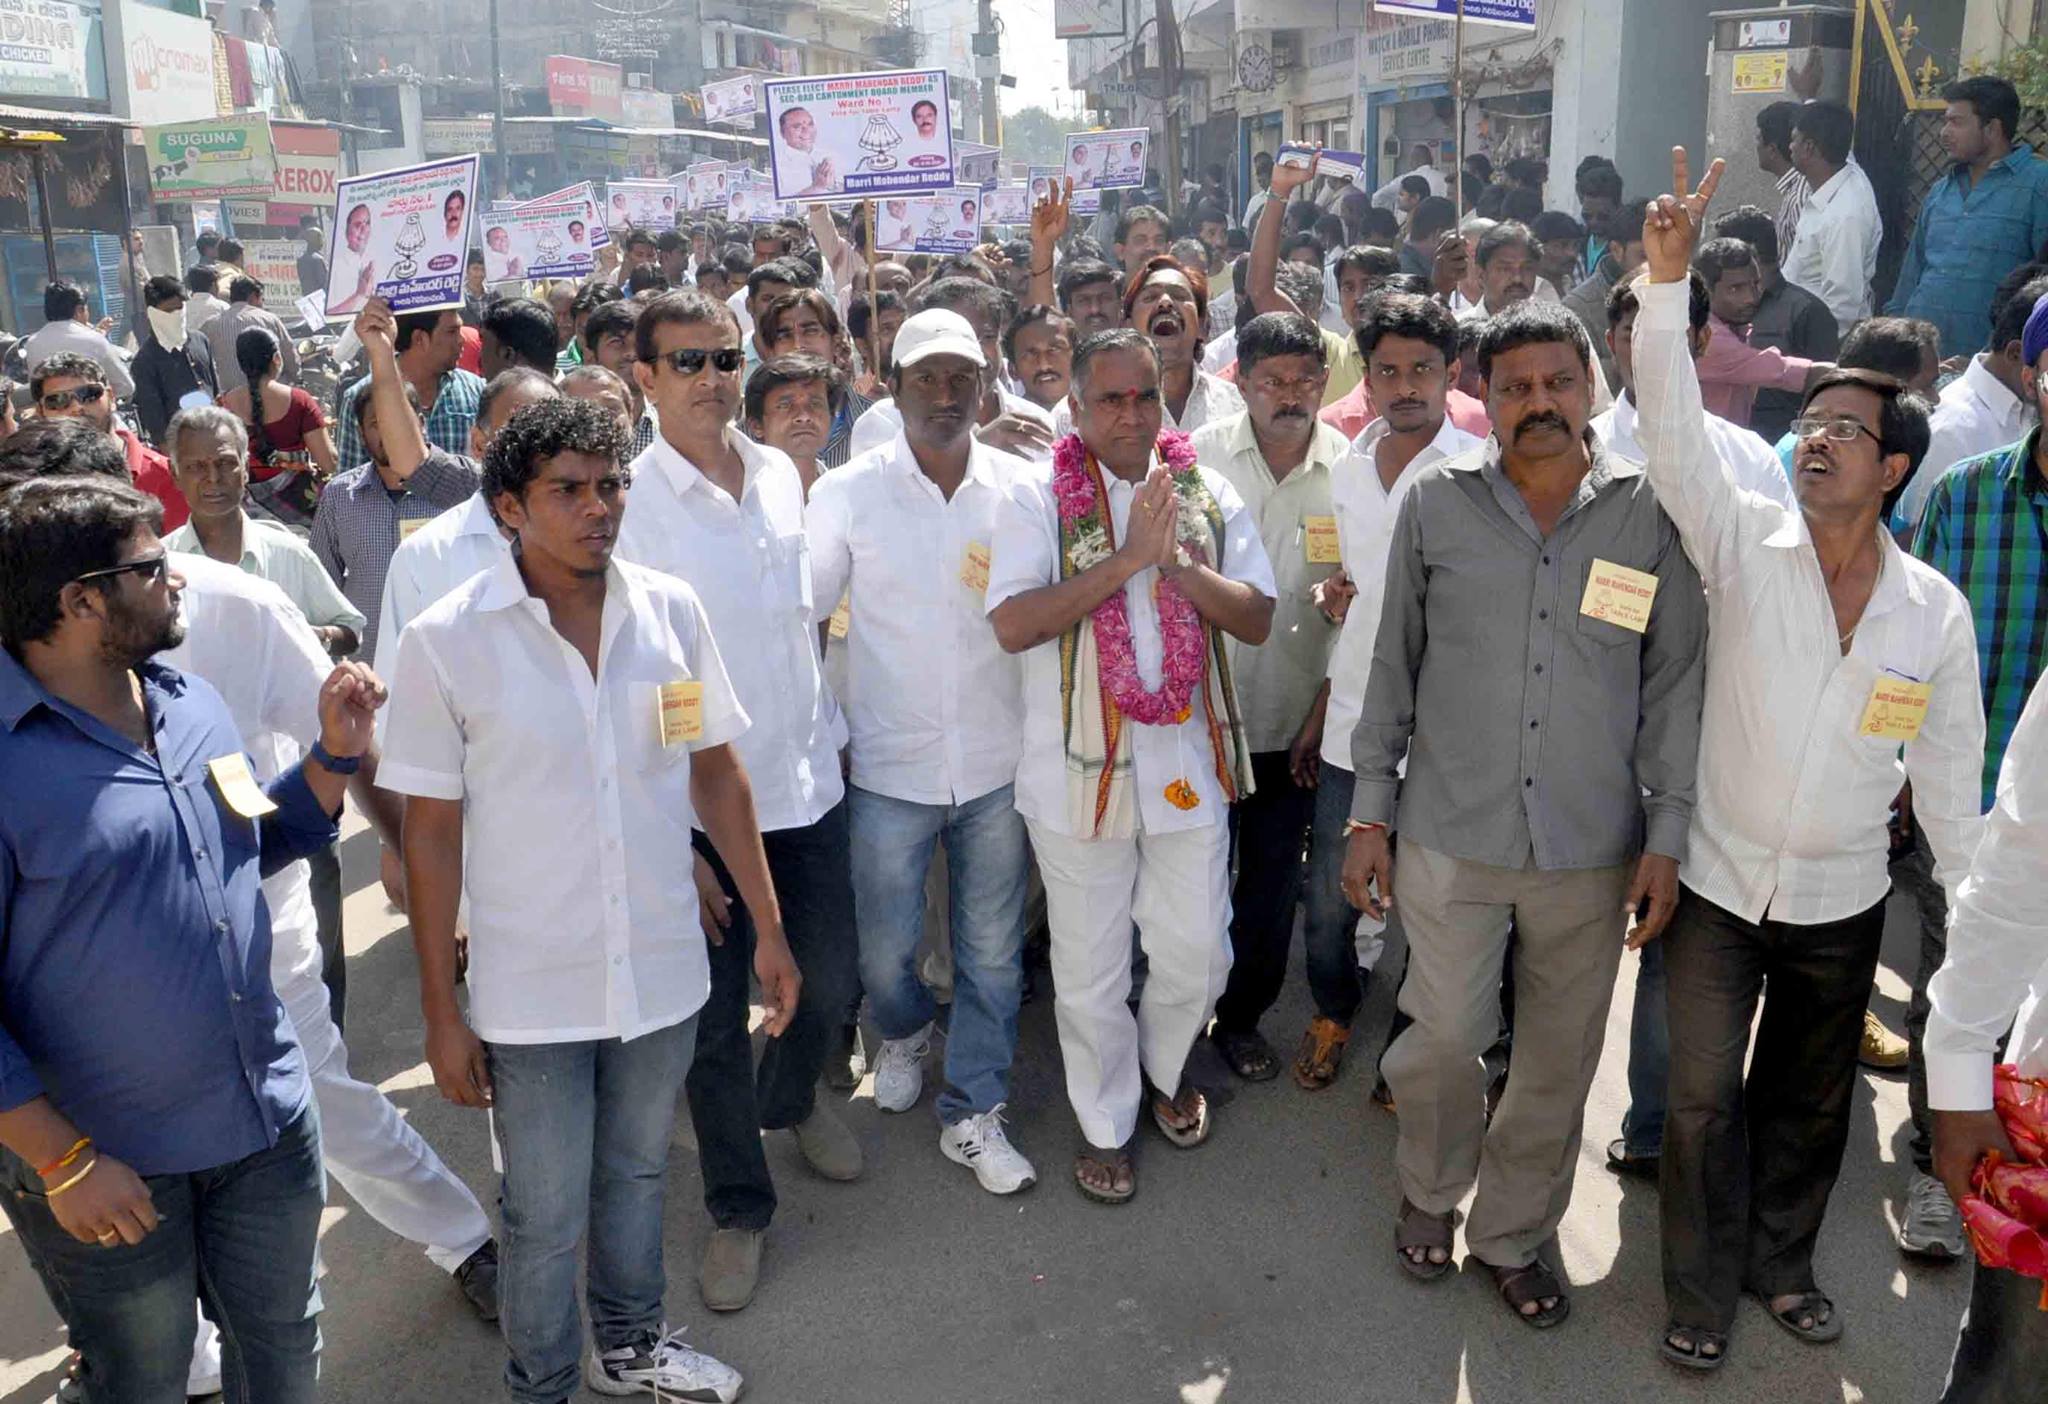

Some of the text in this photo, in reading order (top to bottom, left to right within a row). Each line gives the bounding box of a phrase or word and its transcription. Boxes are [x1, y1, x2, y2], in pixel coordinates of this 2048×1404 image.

[0, 14, 74, 49] DINA
[1424, 19, 1449, 43] PHONES
[1, 46, 46, 60] CHICKEN
[1383, 48, 1430, 73] SERVICE CENTRE
[773, 85, 802, 95] PLEASE
[803, 83, 825, 92] ELECT
[827, 81, 854, 91] MARRI
[901, 75, 926, 84] REDDY
[928, 74, 939, 82] AS
[816, 89, 869, 101] CANTONMENT
[871, 87, 898, 96] BOARD
[900, 84, 934, 94] MEMBER
[837, 99, 864, 108] Ward
[166, 131, 238, 147] SUGUNA
[274, 168, 335, 194] XEROX
[846, 176, 872, 189] Marri
[921, 170, 951, 184] Reddy
